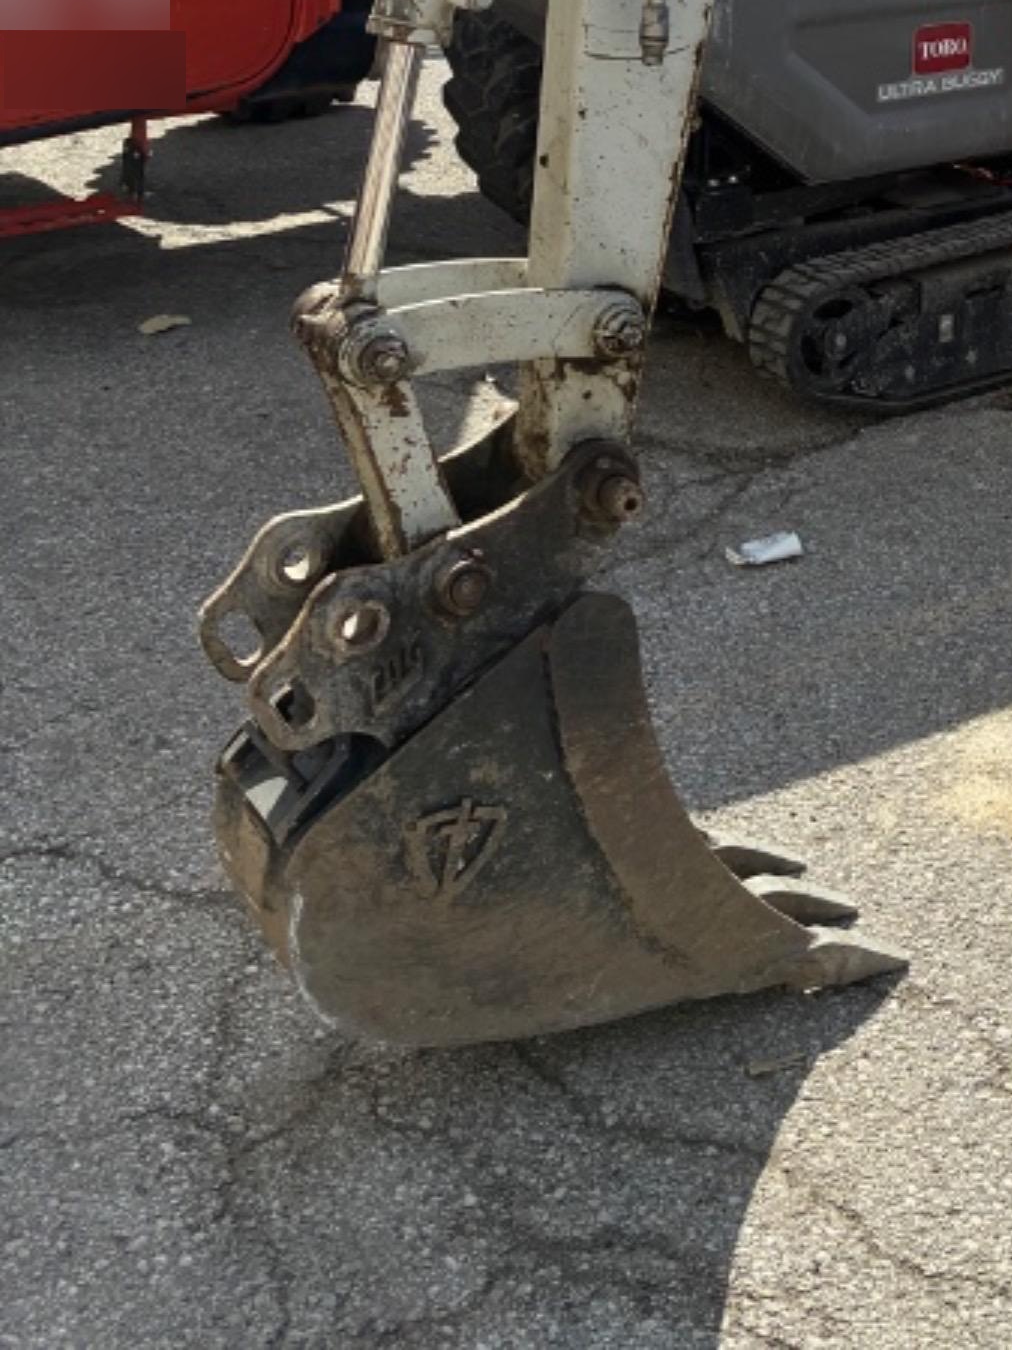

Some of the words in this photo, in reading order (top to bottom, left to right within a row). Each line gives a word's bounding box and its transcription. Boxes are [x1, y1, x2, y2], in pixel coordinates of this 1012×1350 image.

[919, 37, 968, 60] TORO
[877, 80, 937, 102] ULTRA
[941, 68, 1004, 90] BUGGY
